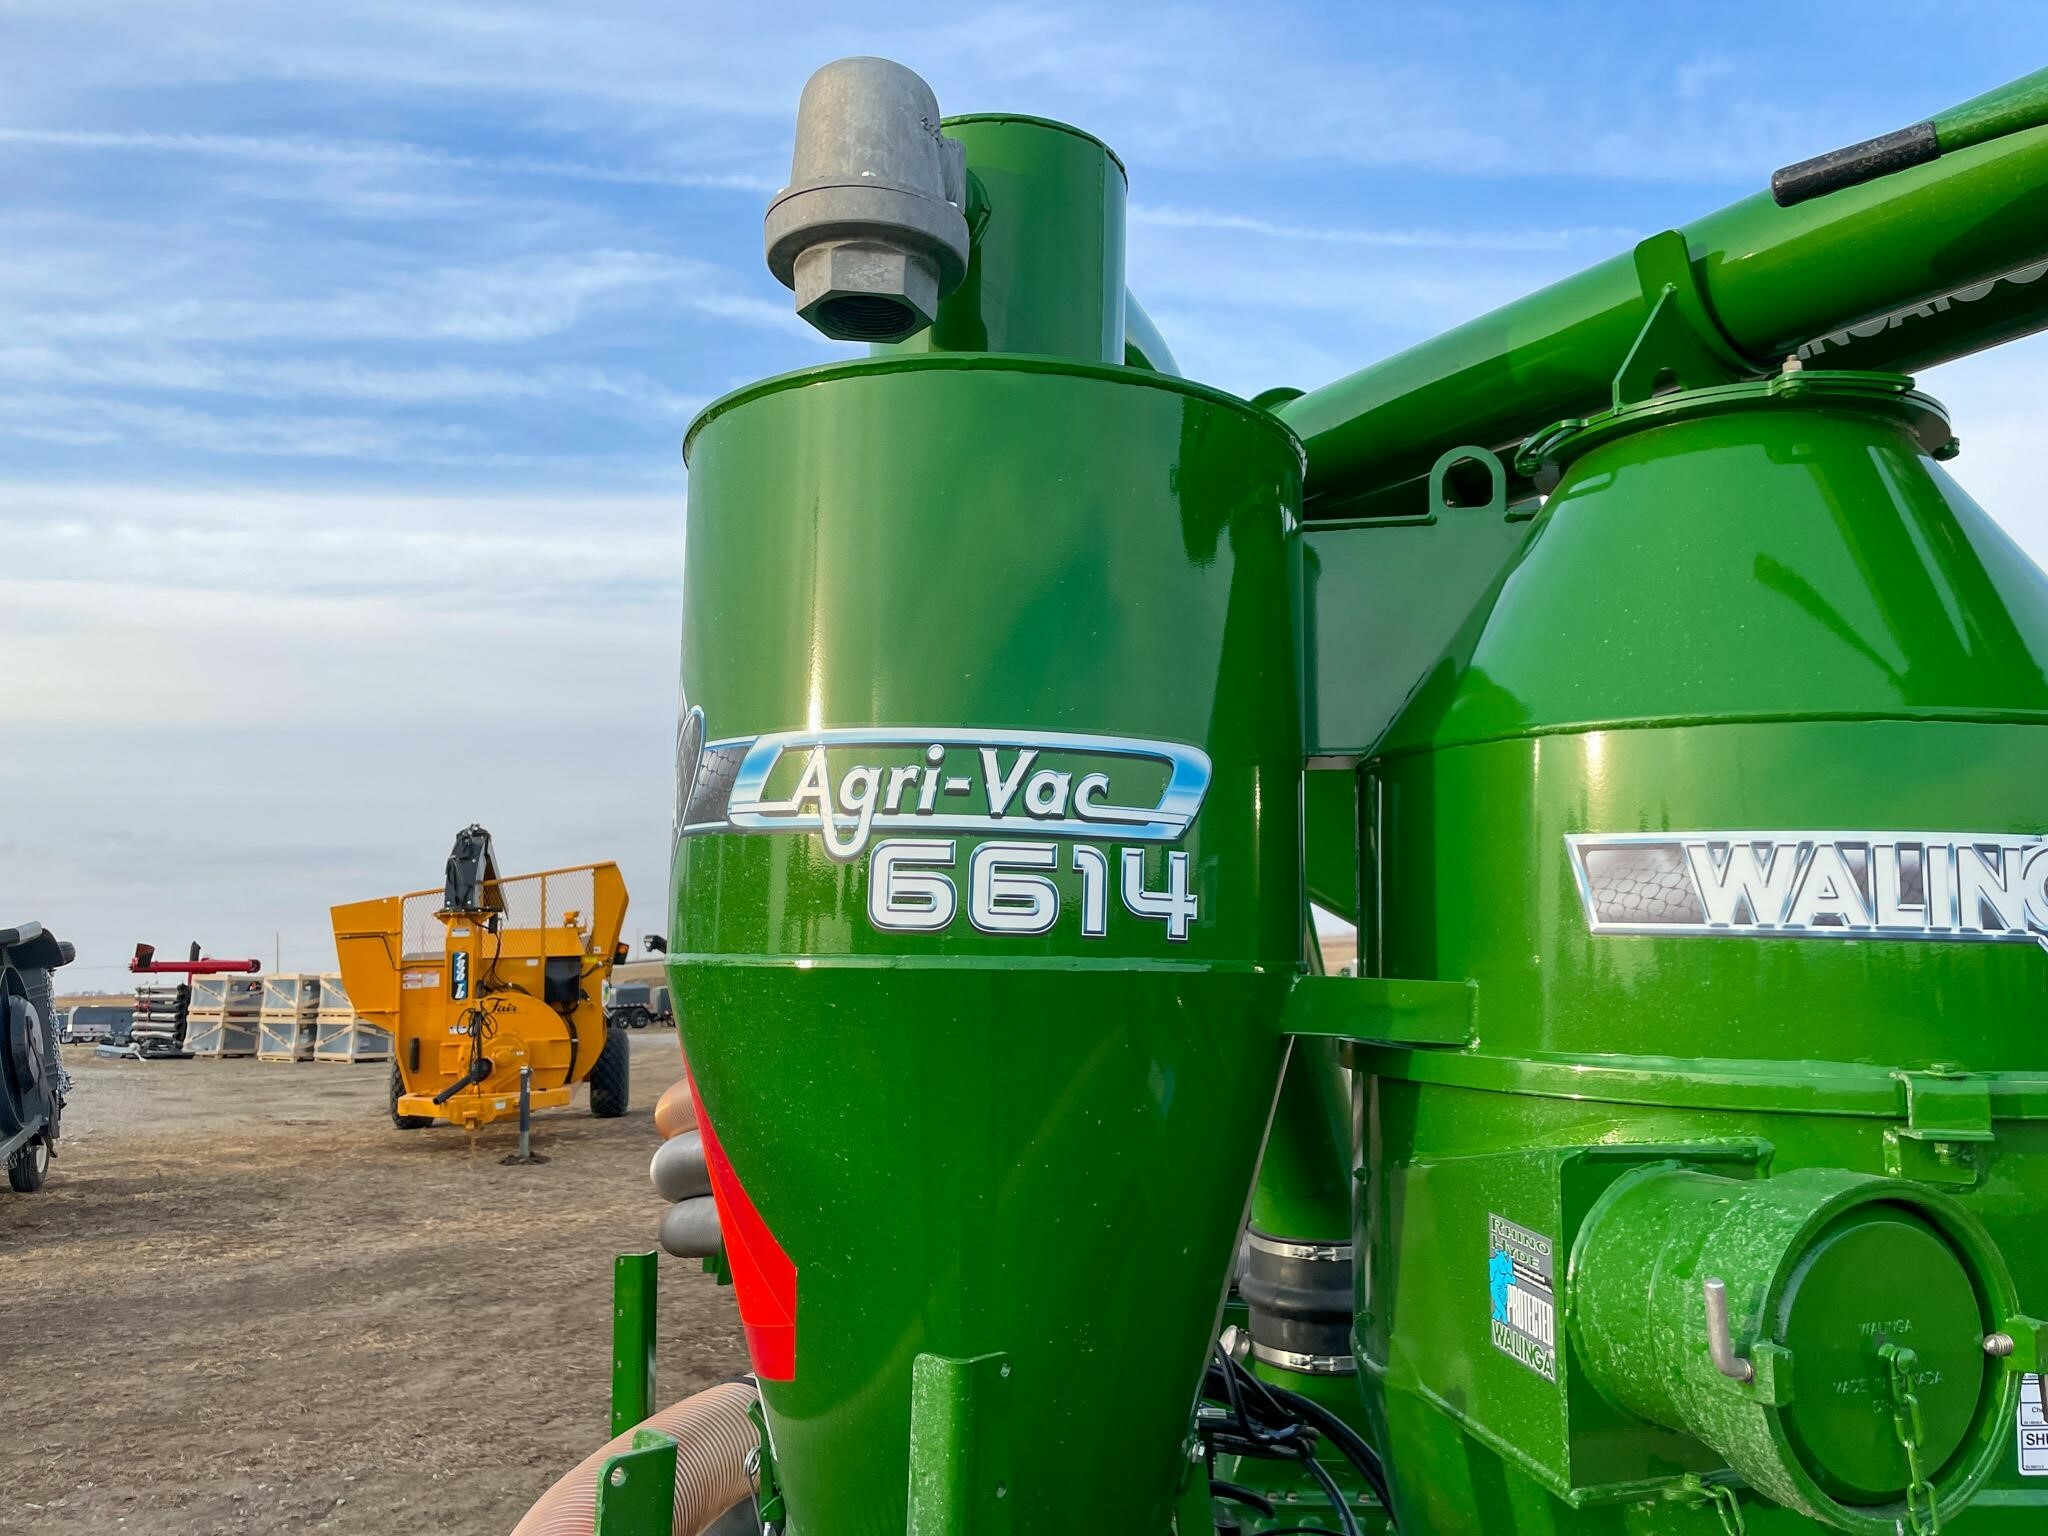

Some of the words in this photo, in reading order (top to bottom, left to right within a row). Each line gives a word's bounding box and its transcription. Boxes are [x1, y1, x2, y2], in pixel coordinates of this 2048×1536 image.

[792, 742, 1112, 860] Agri-Vac
[868, 838, 1199, 942] 6614
[1491, 1216, 1551, 1256] RHINO
[1507, 1284, 1553, 1347] PROTECTED
[1491, 1320, 1555, 1381] WALINGA
